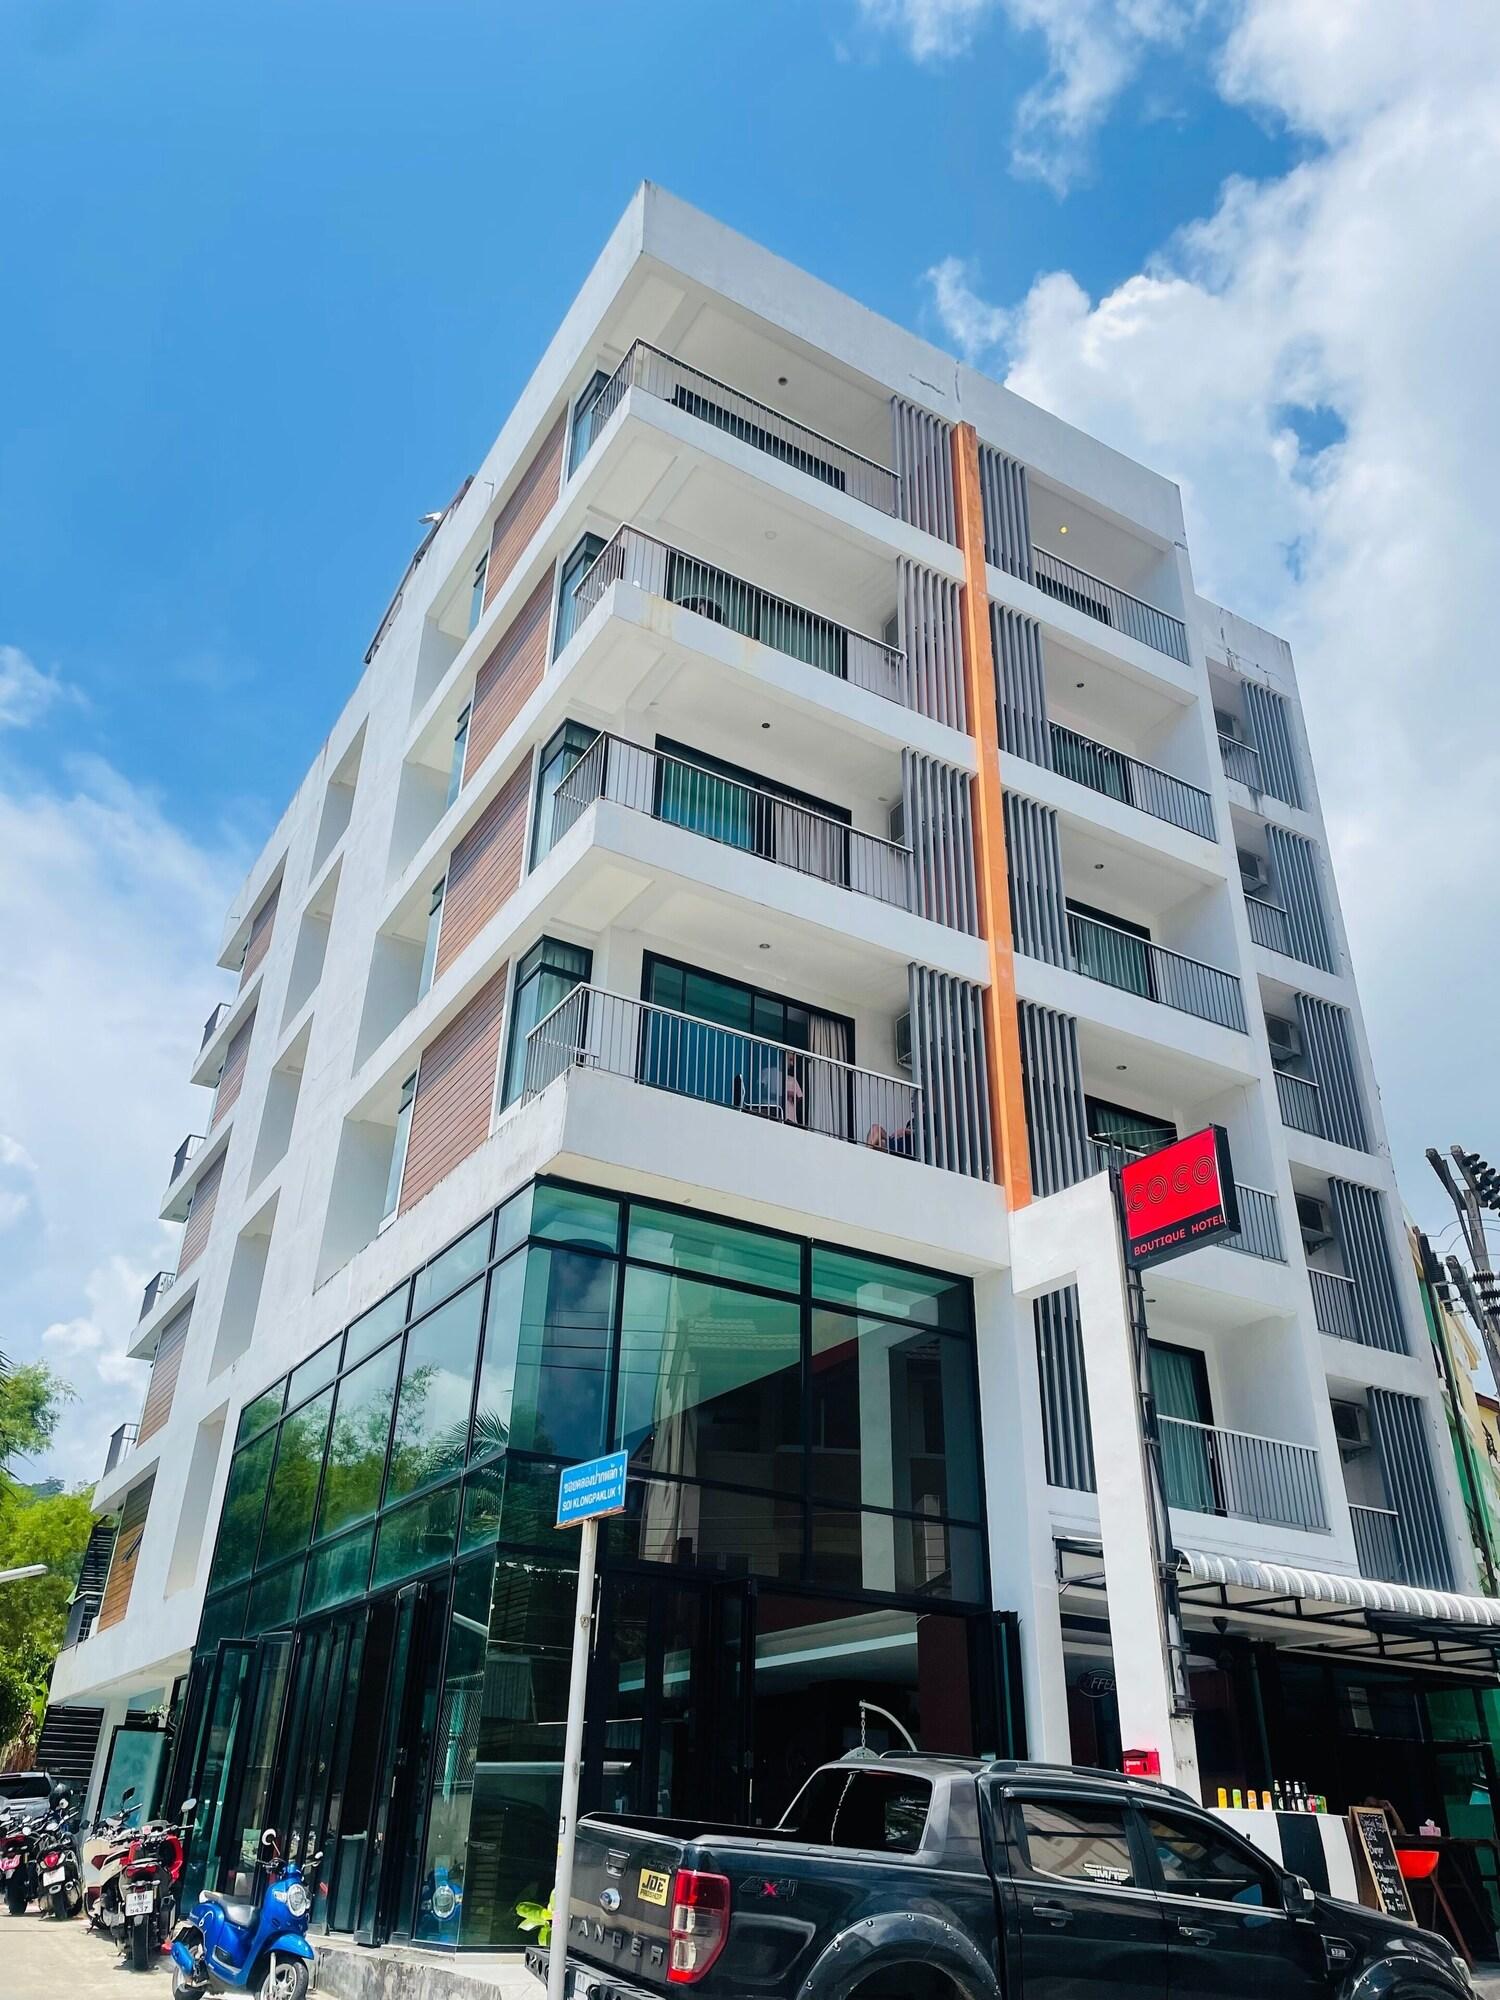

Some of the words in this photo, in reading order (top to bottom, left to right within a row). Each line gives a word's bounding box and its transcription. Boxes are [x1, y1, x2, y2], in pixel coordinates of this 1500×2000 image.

[1127, 1156, 1215, 1212] COCO
[1134, 1229, 1186, 1256] BOUTIQUE
[1191, 1214, 1225, 1234] HOTEL
[562, 1499, 573, 1511] SOI
[573, 1487, 616, 1508] KLONGPAKLUK
[641, 1874, 666, 1893] JOE
